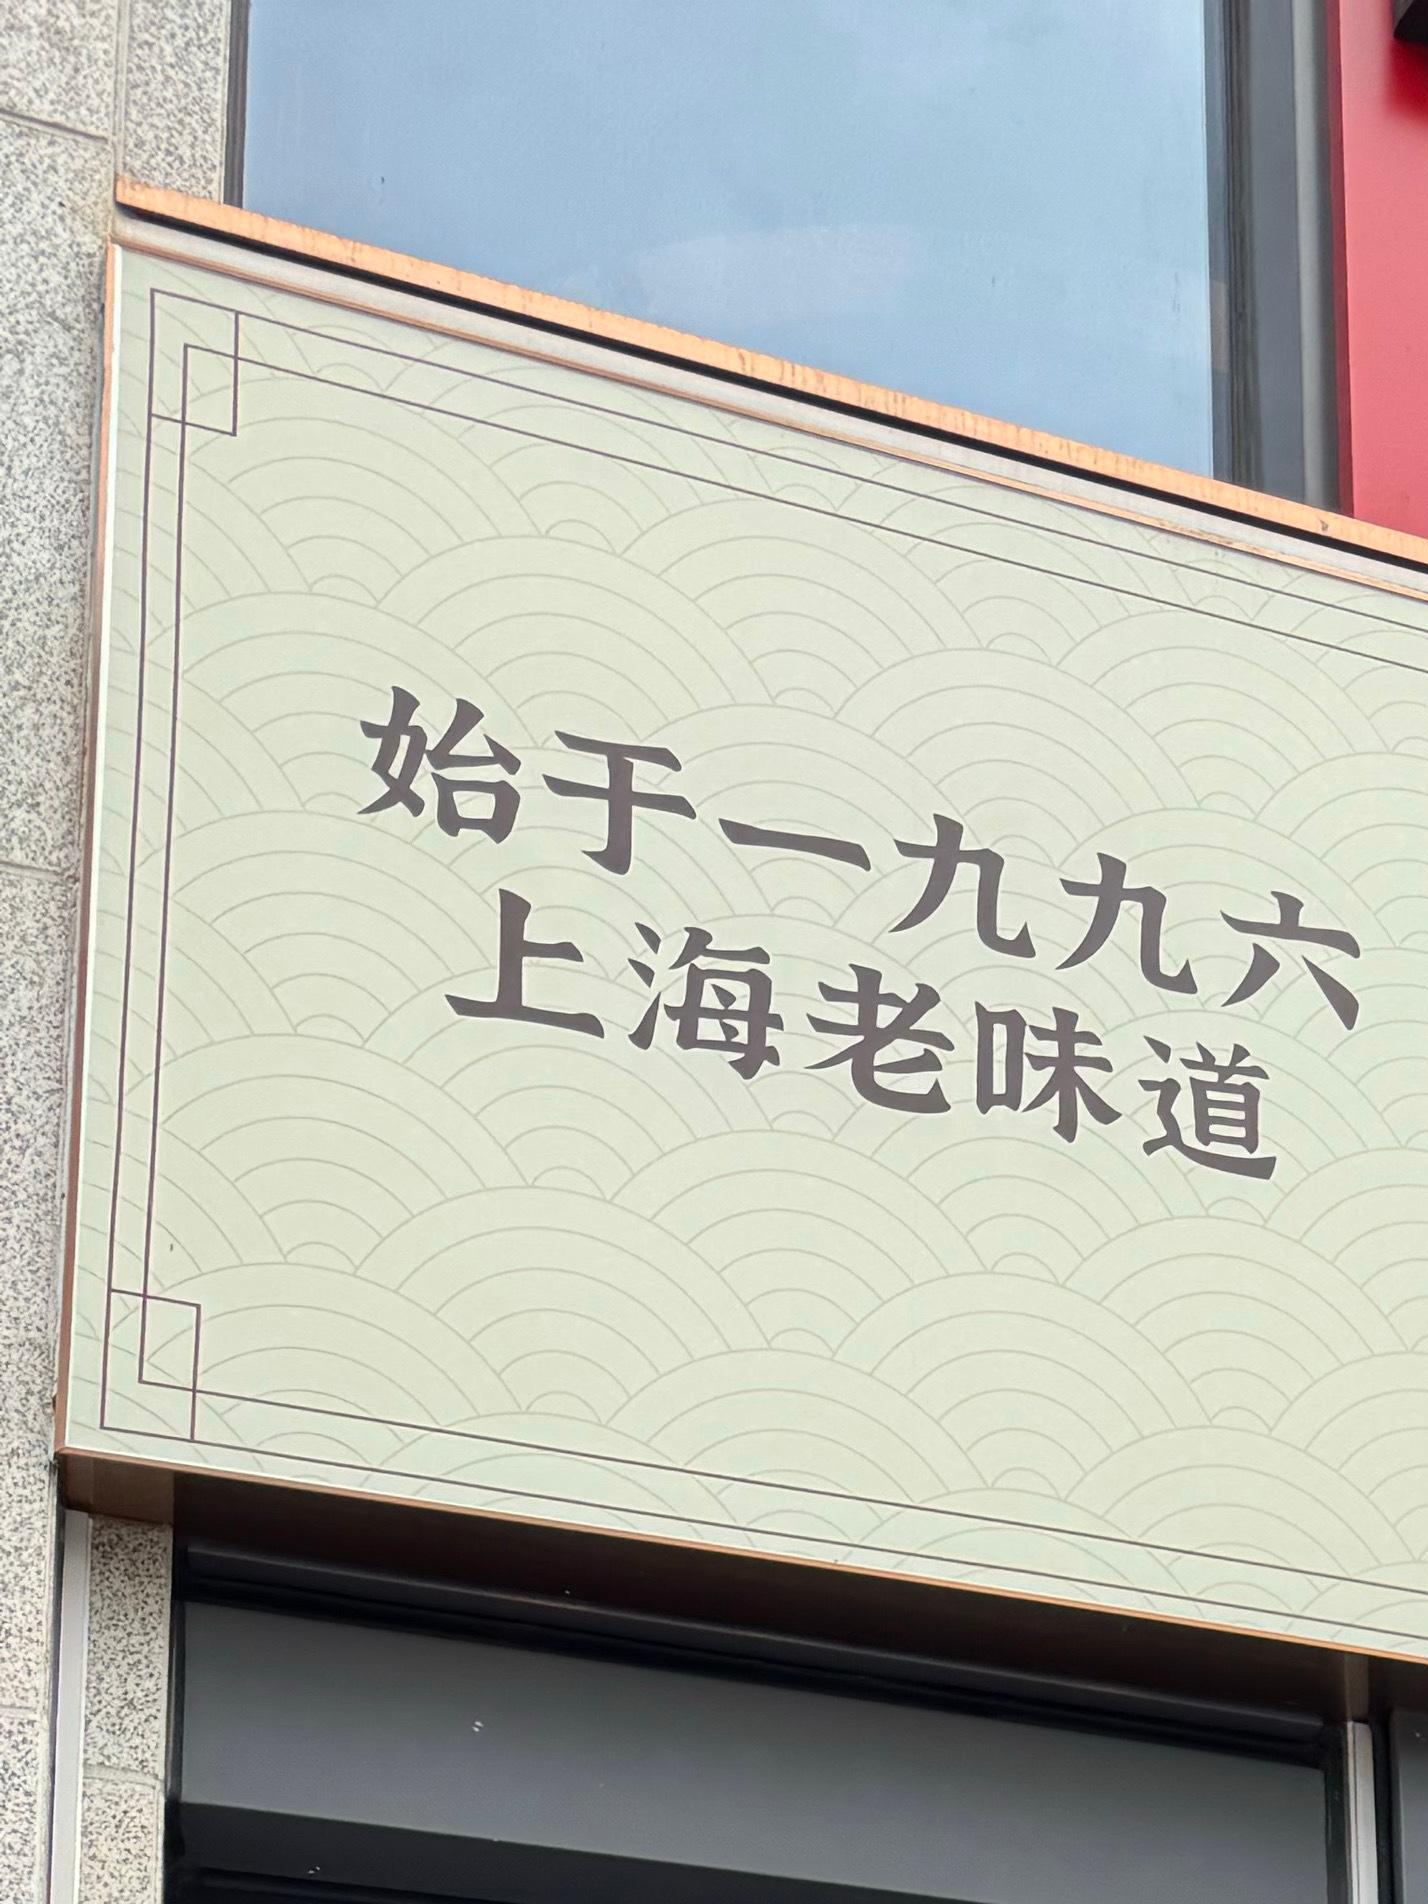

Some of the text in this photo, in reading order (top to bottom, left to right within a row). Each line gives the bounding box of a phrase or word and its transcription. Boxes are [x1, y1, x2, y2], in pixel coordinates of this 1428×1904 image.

[358, 686, 1361, 1031] 始于一九九六
[443, 889, 1277, 1181] 上海老味道
